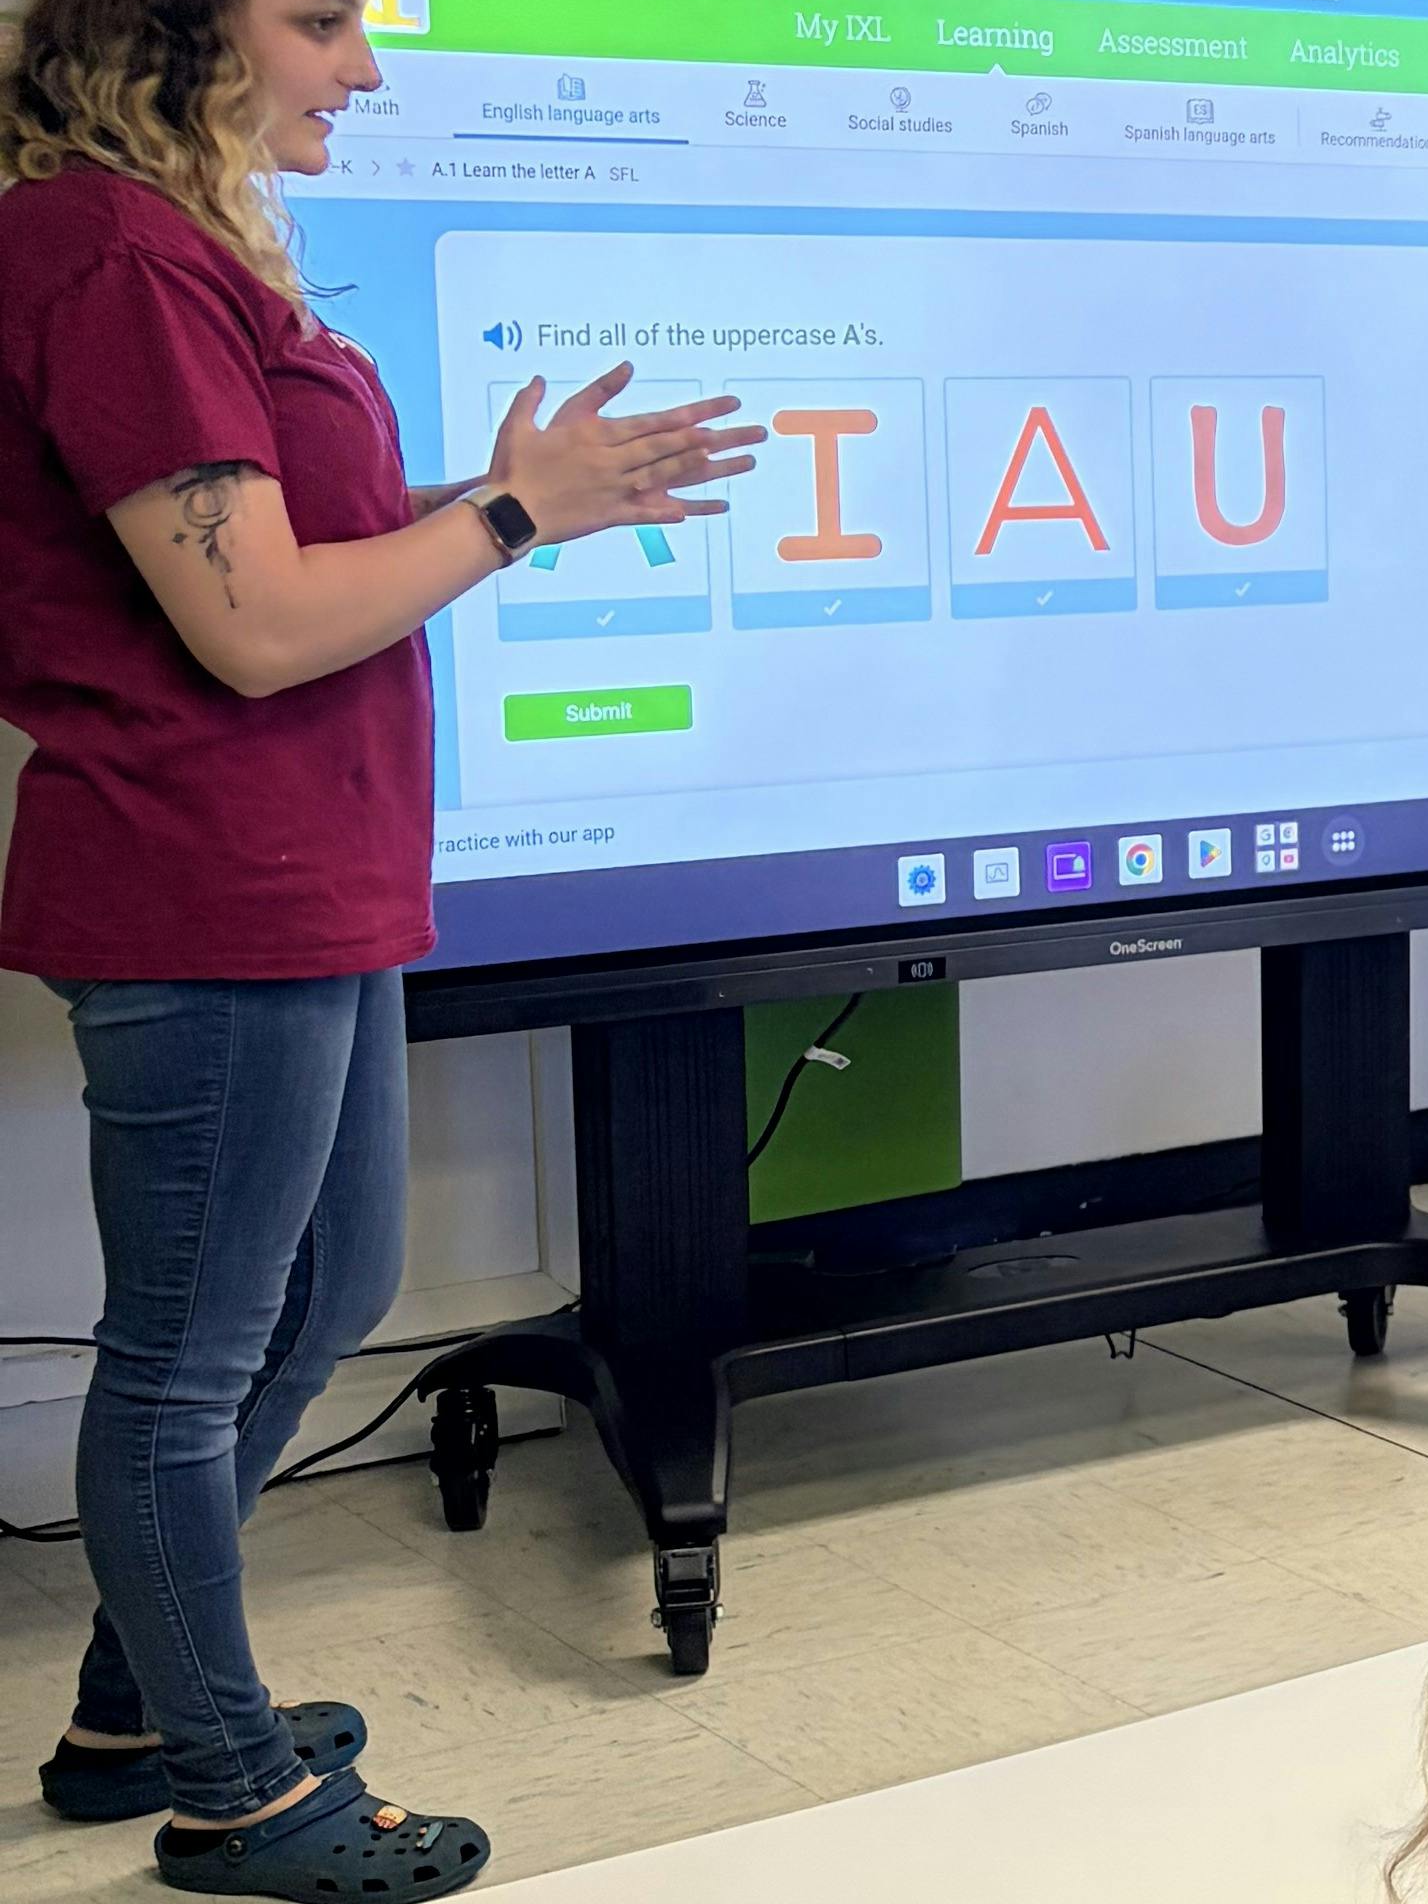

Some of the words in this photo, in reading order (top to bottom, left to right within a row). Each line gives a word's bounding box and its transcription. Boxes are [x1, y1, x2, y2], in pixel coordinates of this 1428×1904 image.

[794, 11, 838, 46] My
[846, 14, 891, 43] IXL
[936, 18, 1055, 55] Learning
[1098, 27, 1248, 61] Assessment
[1289, 38, 1401, 72] Analytics
[354, 97, 400, 116] Math
[482, 102, 544, 124] English
[548, 104, 624, 125] language
[628, 108, 661, 124] arts
[724, 110, 787, 129] Science
[848, 114, 895, 132] Social
[899, 116, 953, 134] studies
[1010, 119, 1069, 139] Spanish
[1124, 124, 1180, 143] Spanish
[1183, 127, 1246, 147] language
[1249, 130, 1276, 145] arts
[431, 162, 457, 177] A.1
[462, 163, 503, 179] Learn
[511, 163, 537, 180] the
[540, 164, 580, 181] letter
[583, 165, 597, 181] A
[608, 166, 640, 183] SFL
[537, 322, 591, 347] Find
[598, 322, 627, 347] all
[634, 322, 660, 347] of
[667, 322, 706, 347] the
[712, 325, 837, 351] uppercase
[842, 322, 884, 347] A's.
[772, 409, 882, 561] I
[974, 405, 1110, 556] A
[1190, 404, 1286, 547] U
[565, 701, 633, 723] Submit
[438, 834, 500, 854] ractice
[505, 828, 543, 848] with
[548, 828, 578, 845] our
[582, 825, 616, 845] app
[1109, 936, 1184, 957] OneScreen
